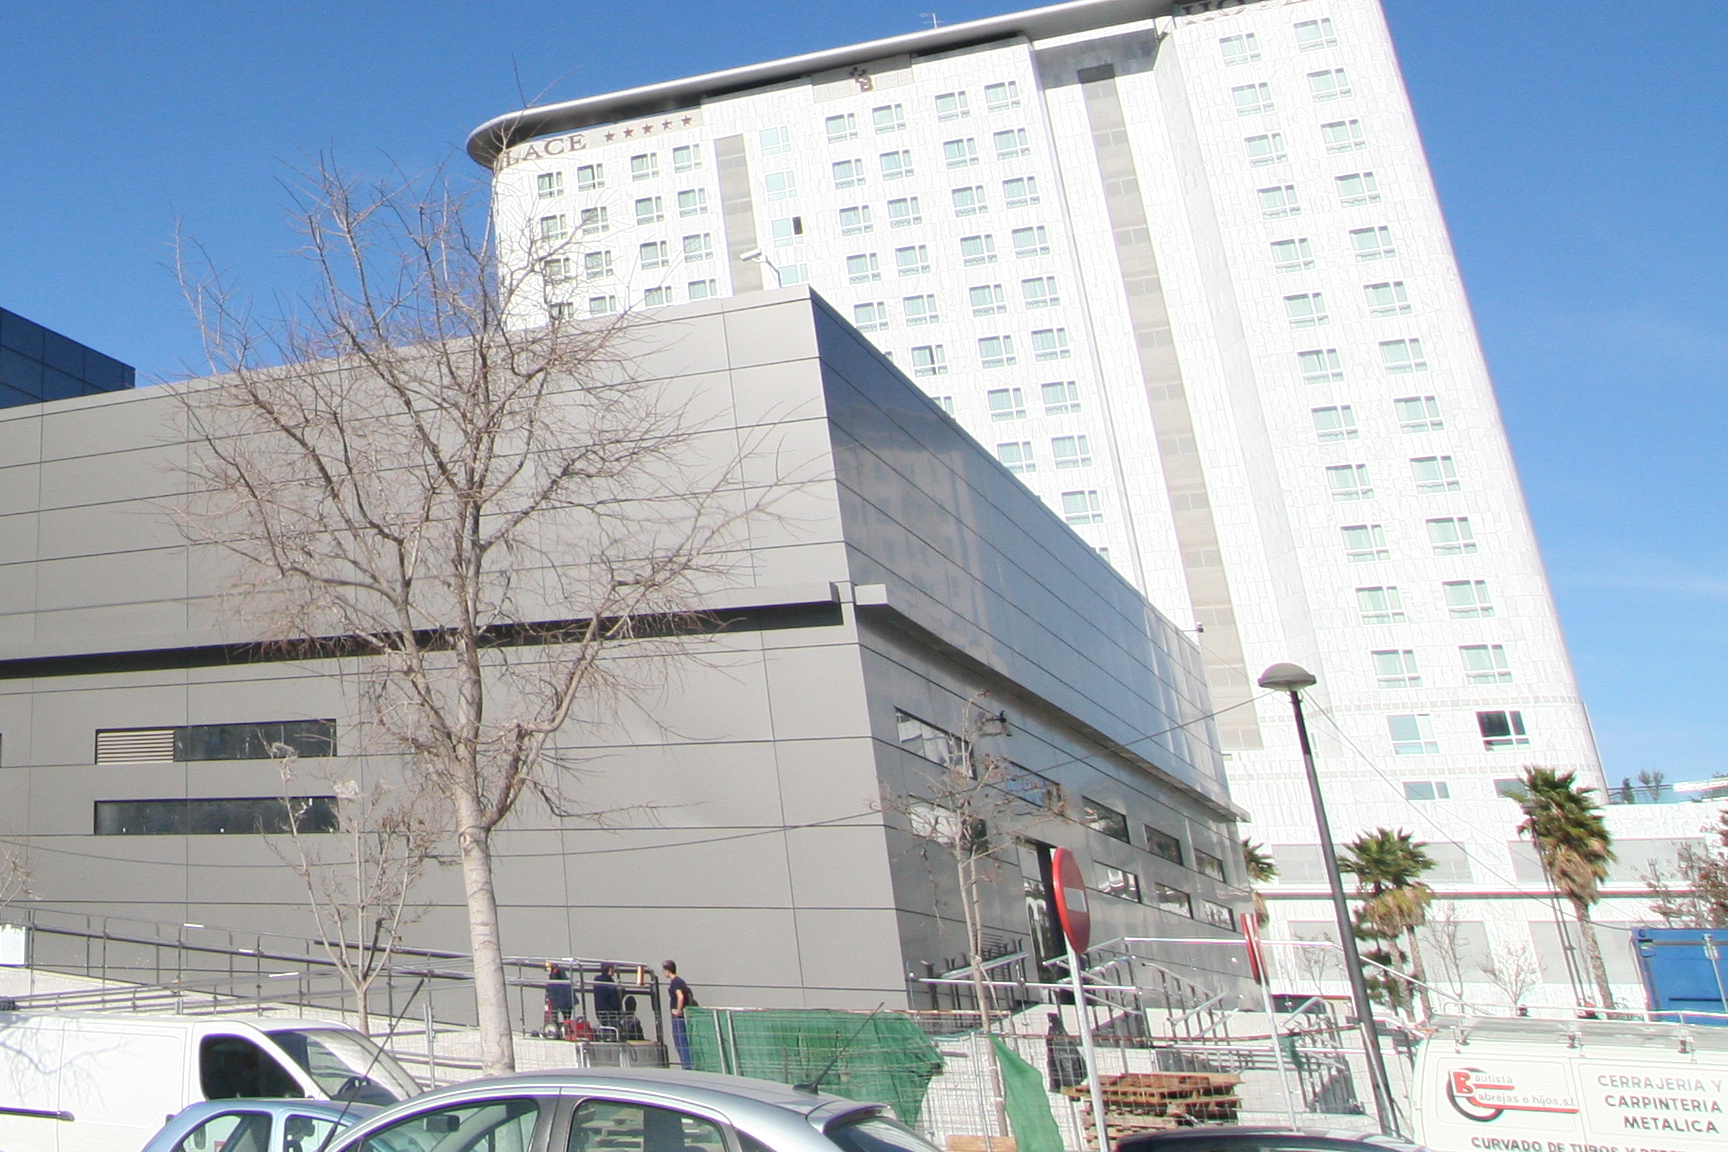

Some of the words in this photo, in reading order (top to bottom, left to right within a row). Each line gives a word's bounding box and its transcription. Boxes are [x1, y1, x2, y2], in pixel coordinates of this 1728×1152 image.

[1597, 1074, 1706, 1092] CERRAJERIA
[1710, 1079, 1723, 1093] Y
[1604, 1095, 1724, 1114] CARPINTERIA
[1623, 1115, 1721, 1134] METALICA
[1471, 1136, 1543, 1151] CURVADO
[1547, 1141, 1566, 1152] DE
